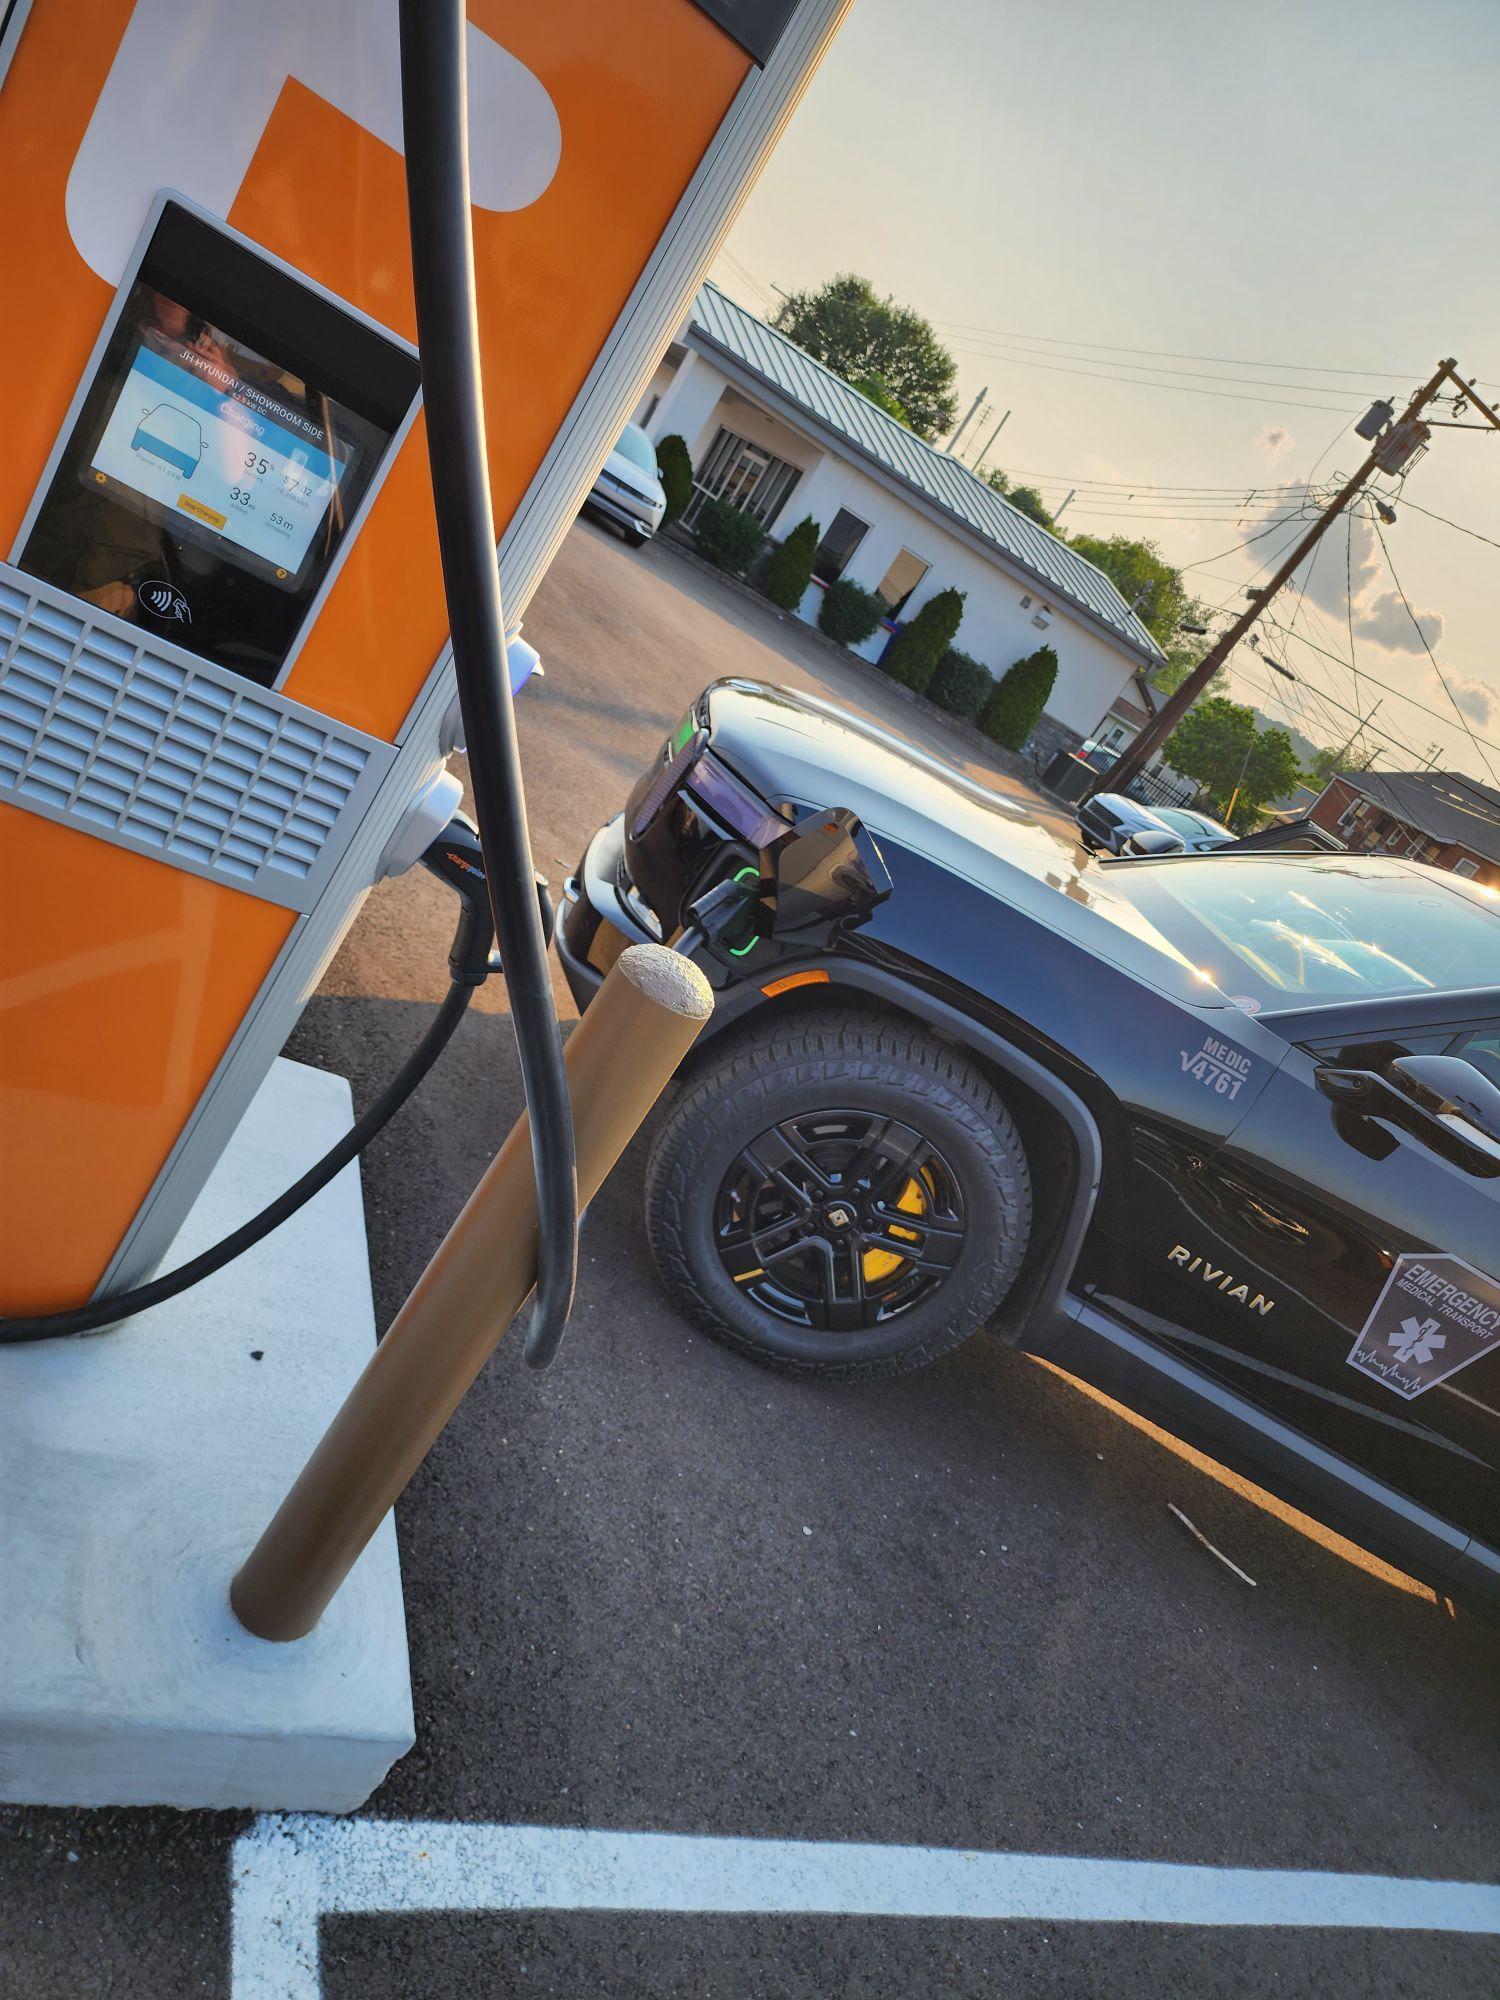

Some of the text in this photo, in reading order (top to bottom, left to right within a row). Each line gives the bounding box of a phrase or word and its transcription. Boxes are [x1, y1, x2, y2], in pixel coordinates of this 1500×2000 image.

[180, 350, 194, 363] JH
[195, 357, 238, 389] HYUNDAI
[245, 388, 302, 427] SHOWROOM
[302, 422, 324, 440] SIDE
[257, 407, 268, 416] DC
[220, 403, 265, 437] Charging
[283, 476, 313, 497] $712
[270, 512, 284, 525] 53
[283, 520, 294, 531] m
[1202, 1036, 1252, 1075] MEDIC
[1167, 1244, 1275, 1316] RIVIAN
[1396, 1278, 1494, 1340] MEDICAL TRANSPORT
